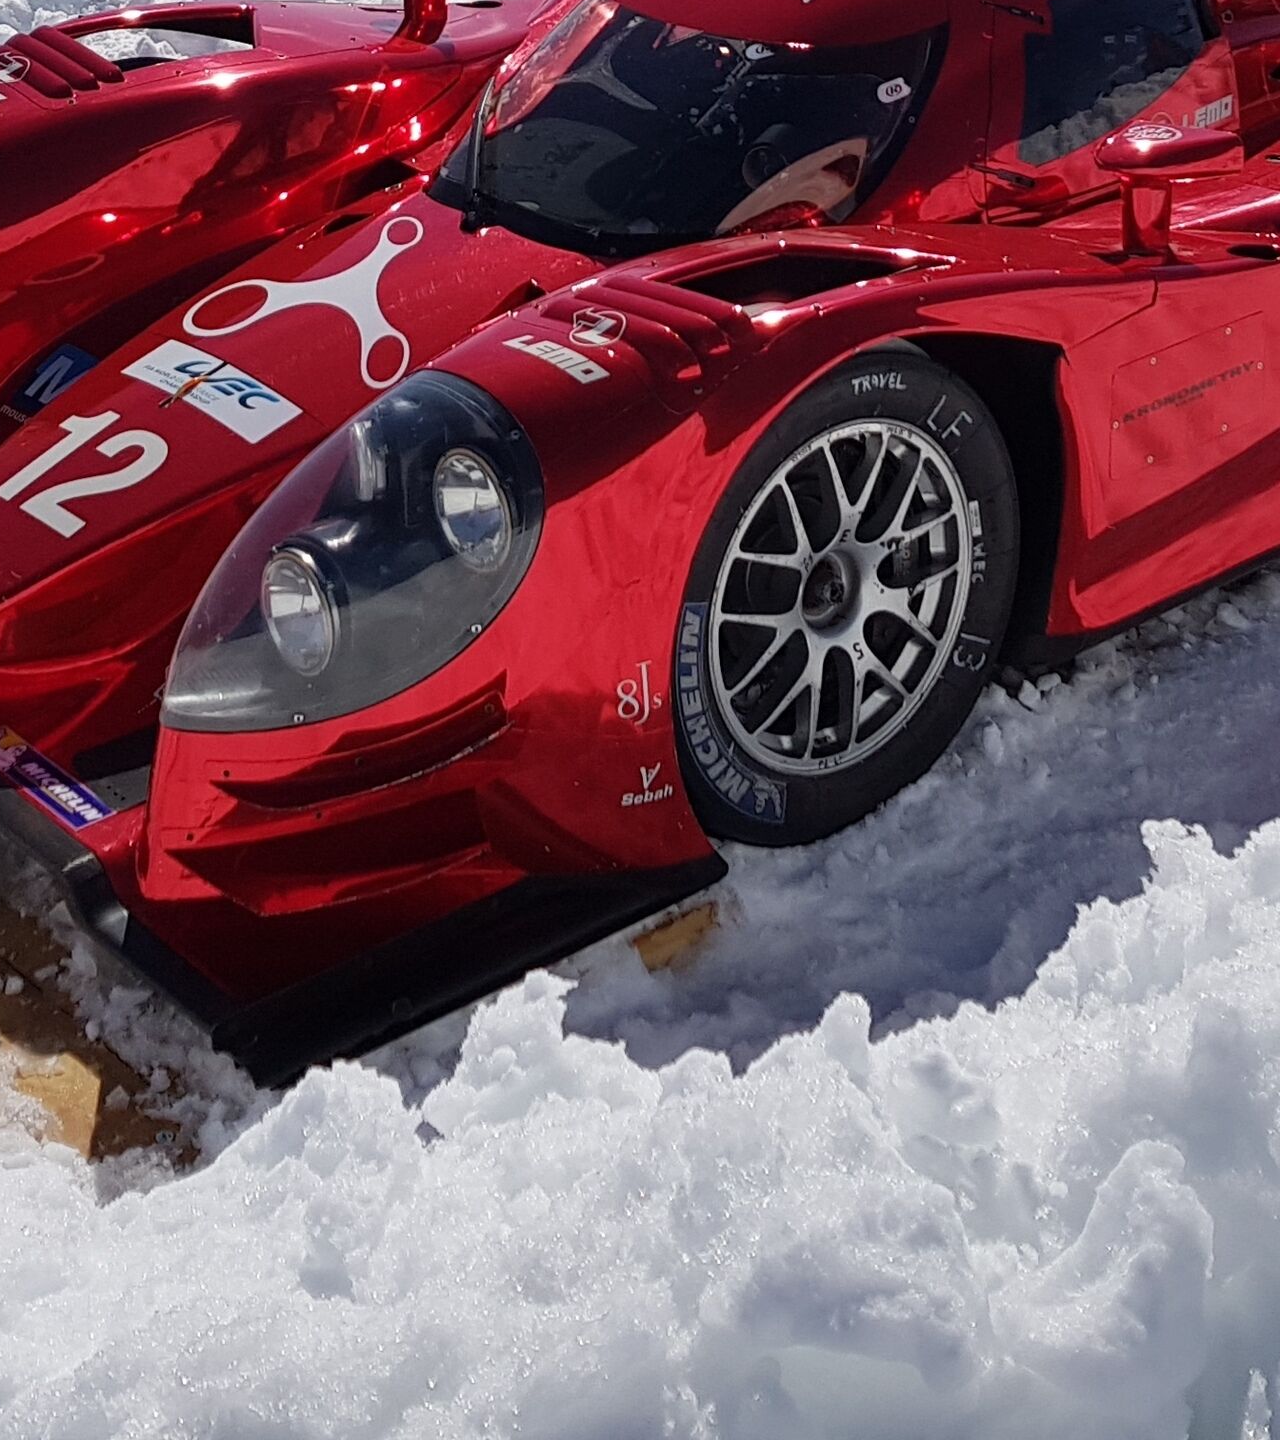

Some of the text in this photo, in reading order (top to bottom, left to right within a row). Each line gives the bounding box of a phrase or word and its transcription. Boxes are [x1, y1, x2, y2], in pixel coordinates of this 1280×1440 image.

[501, 334, 611, 385] LEMO
[173, 360, 281, 410] WEC
[851, 372, 908, 396] TRAVEL
[0, 404, 28, 424] mous
[926, 394, 973, 440] LF
[971, 541, 987, 585] WEC
[678, 609, 752, 805] MICHELIN
[20, 761, 104, 822] MICHELIN
[620, 783, 674, 807] Sebah
